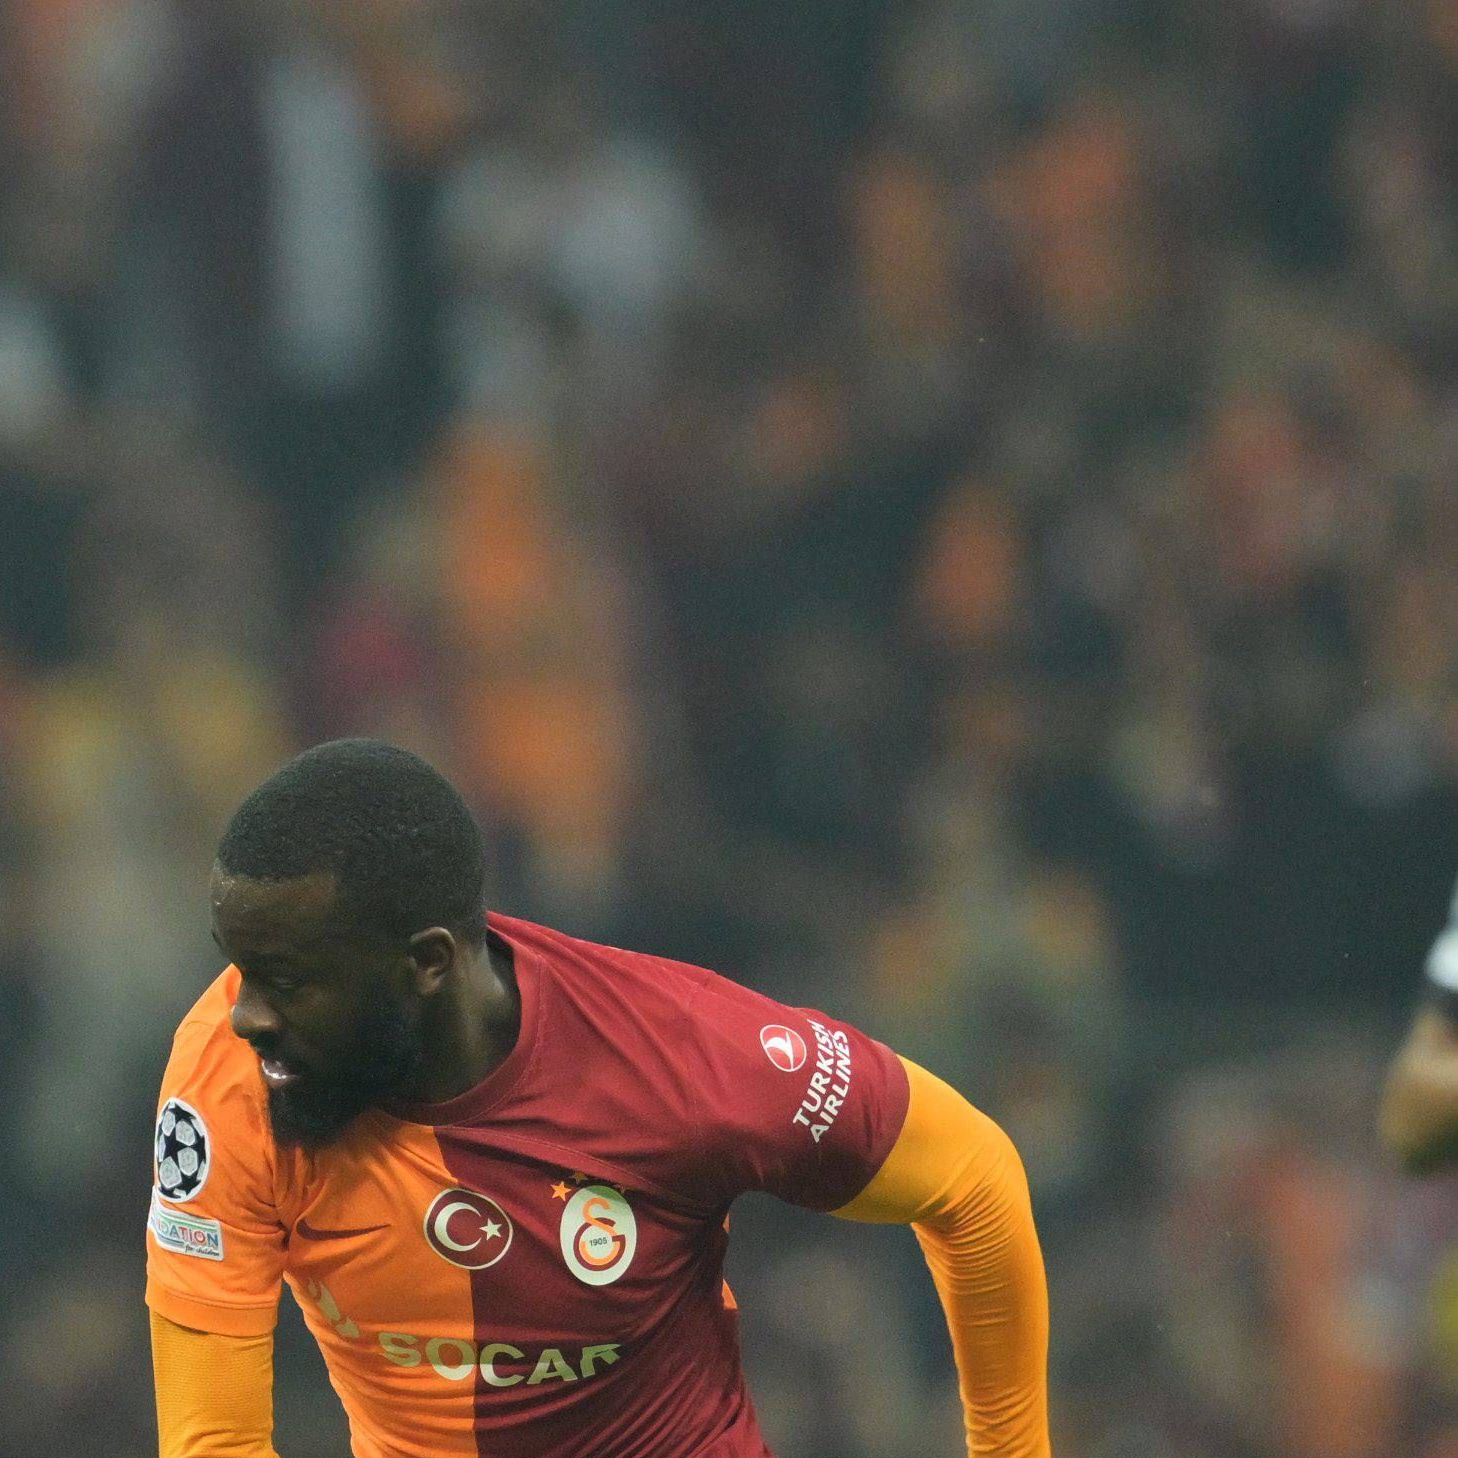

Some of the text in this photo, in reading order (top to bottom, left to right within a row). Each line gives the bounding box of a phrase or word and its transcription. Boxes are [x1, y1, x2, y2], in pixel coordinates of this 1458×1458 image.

[792, 1018, 835, 1126] TURKISH
[810, 1030, 852, 1143] AIRLINES
[589, 1237, 609, 1247] 1905
[378, 1332, 622, 1387] SOCAR
